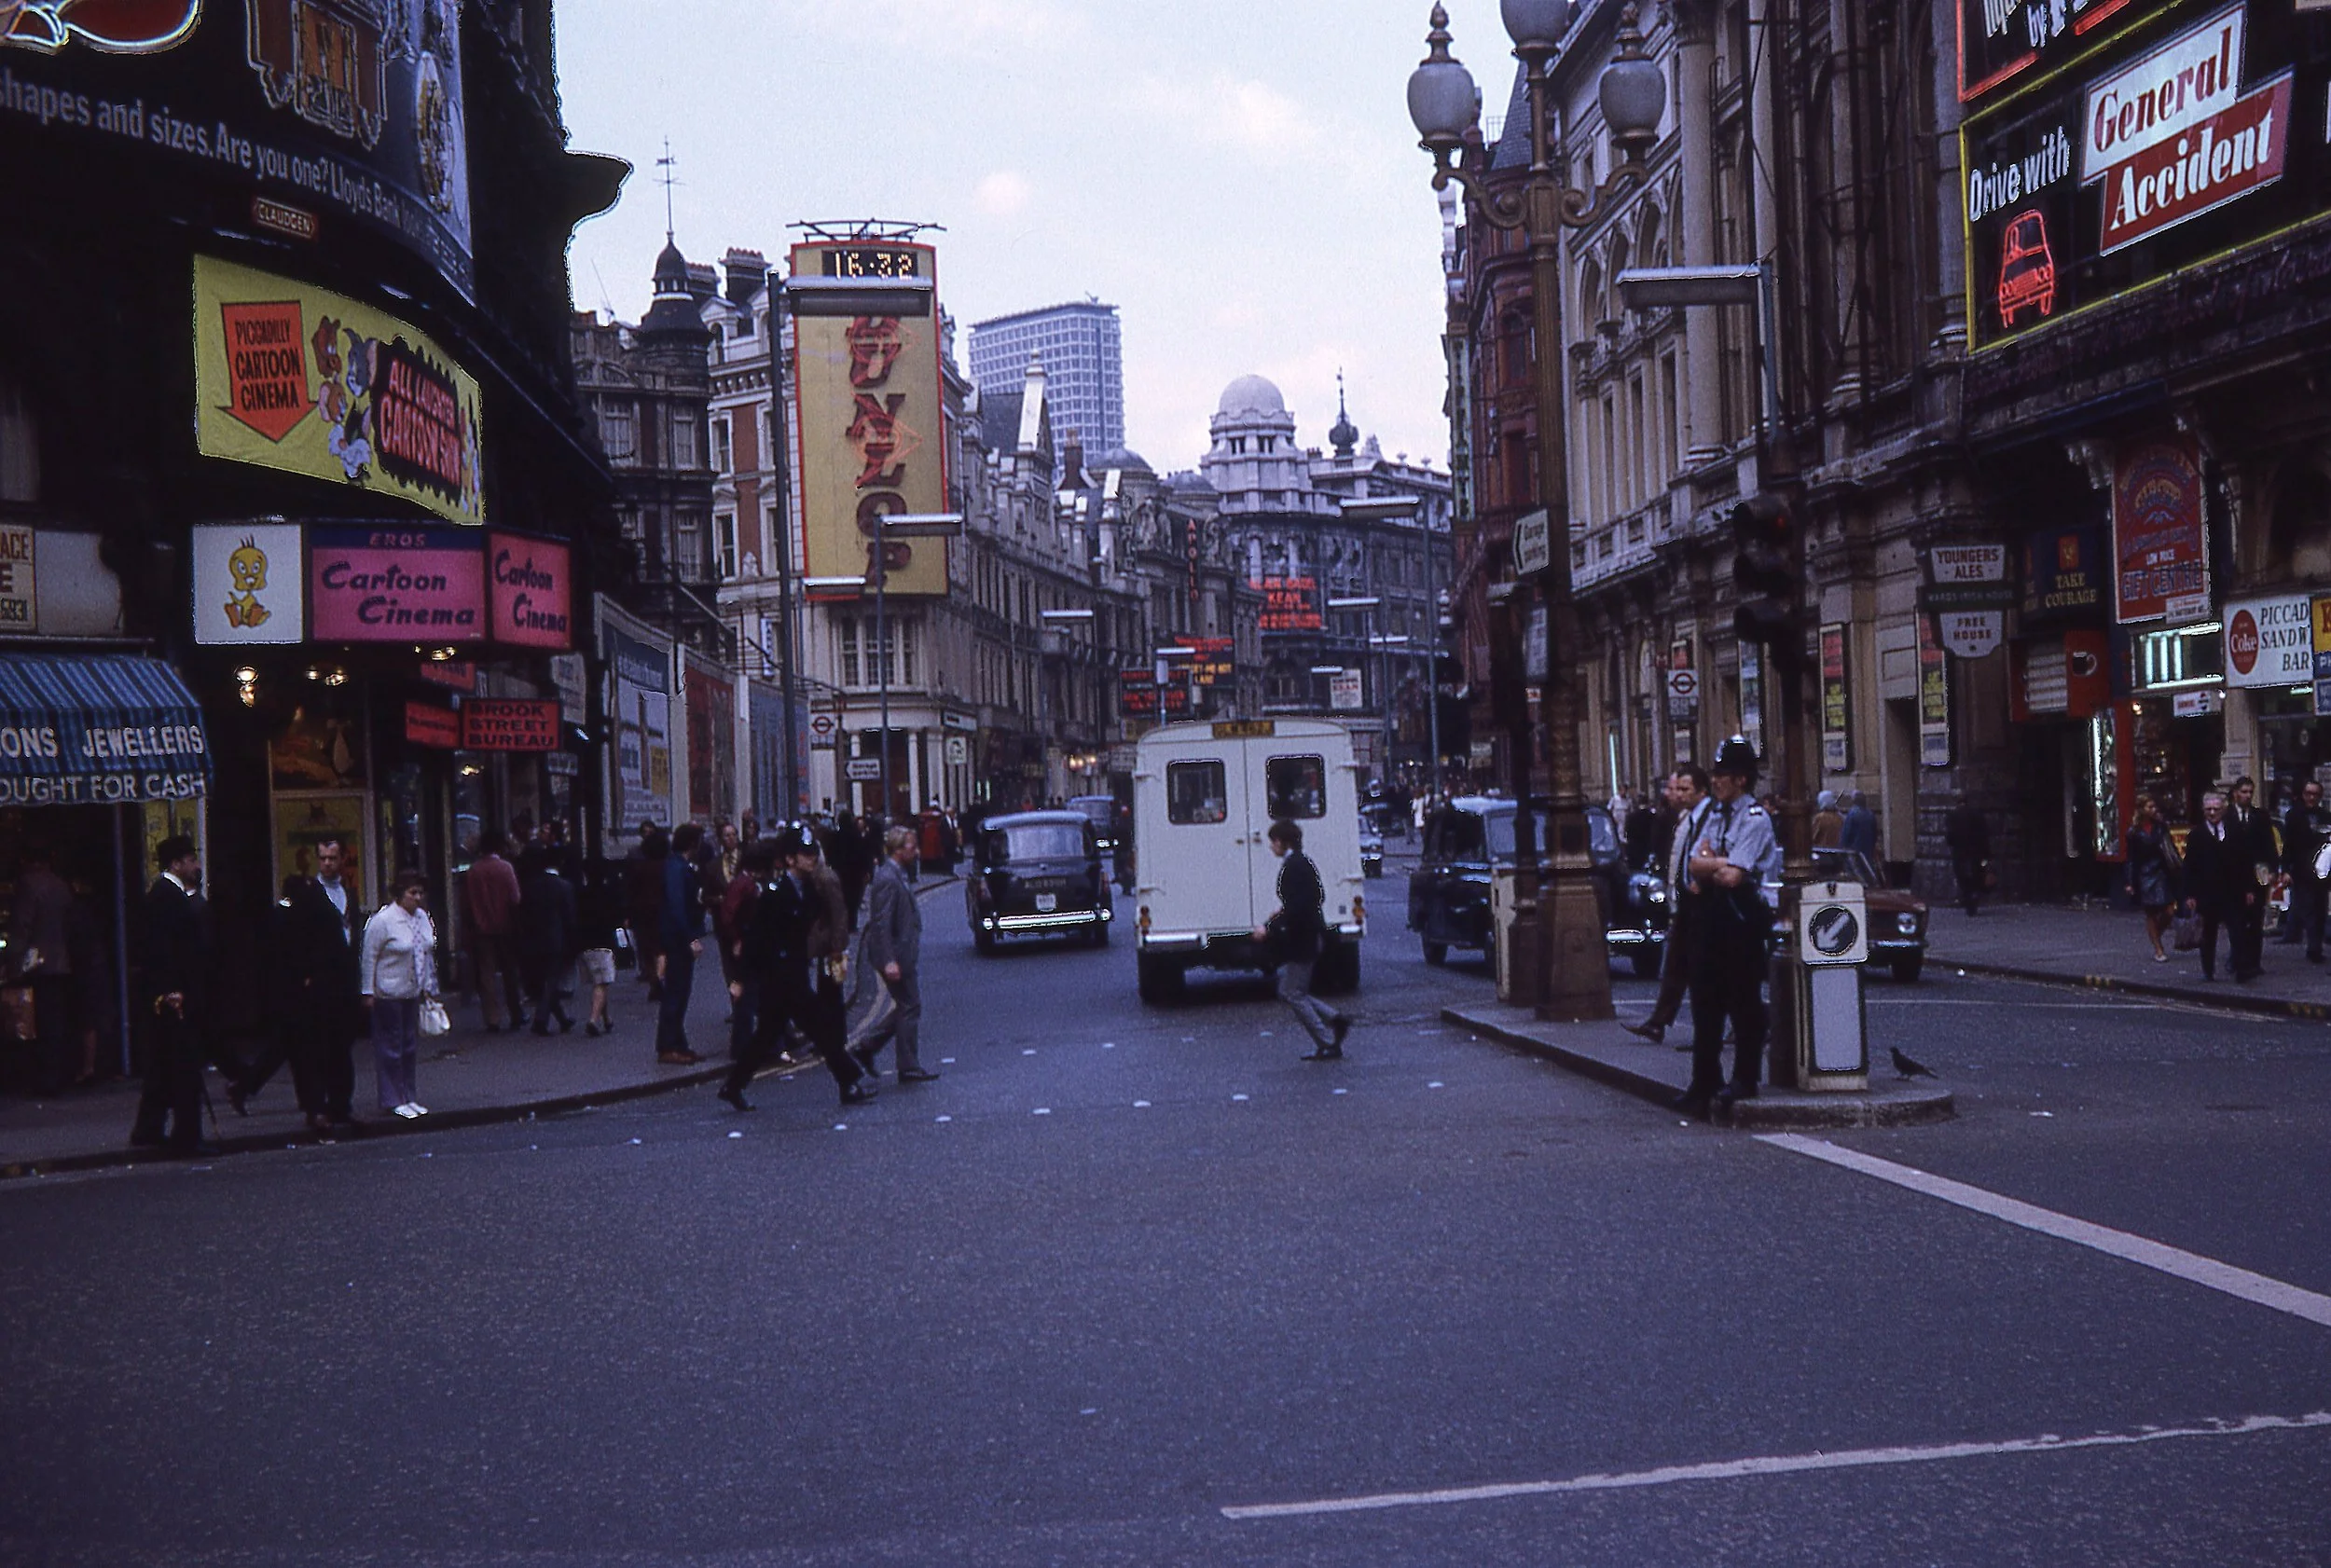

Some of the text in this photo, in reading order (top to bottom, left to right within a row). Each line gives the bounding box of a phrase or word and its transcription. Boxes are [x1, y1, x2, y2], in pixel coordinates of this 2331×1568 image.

[2093, 28, 2232, 153] General
[0, 68, 90, 126] hapes
[98, 99, 144, 139] and
[216, 122, 253, 170] Are
[255, 144, 289, 180] you
[292, 155, 329, 194] one?
[330, 161, 373, 214] Lloyds
[1970, 125, 2071, 223] Drive with
[2110, 106, 2273, 231] Accident
[235, 318, 292, 346] PICCADILLY
[235, 350, 301, 380] CARTOON
[241, 383, 299, 412] CINEMA
[369, 533, 426, 547] EROS
[494, 548, 554, 590] Cartoon
[1936, 548, 1999, 564] YOUNGERS
[322, 560, 447, 590] Cartoon
[1954, 565, 1983, 579] ALES
[2055, 572, 2086, 589] TAKE
[2122, 558, 2202, 601] GIFT CENTRE
[358, 595, 476, 624] Cinema
[514, 592, 568, 633] Cinema
[2045, 589, 2098, 609] COURAGE
[1952, 628, 1992, 640] HOUSE
[1957, 616, 1986, 627] FREE
[2230, 633, 2257, 653] Coke
[2261, 626, 2310, 650] SANDW
[2283, 652, 2310, 671] BAR
[469, 719, 548, 732] STREET
[82, 725, 204, 757] JEWELLERS
[468, 734, 554, 747] BUREAU
[90, 775, 136, 799] FOR
[145, 772, 205, 796] CASH
